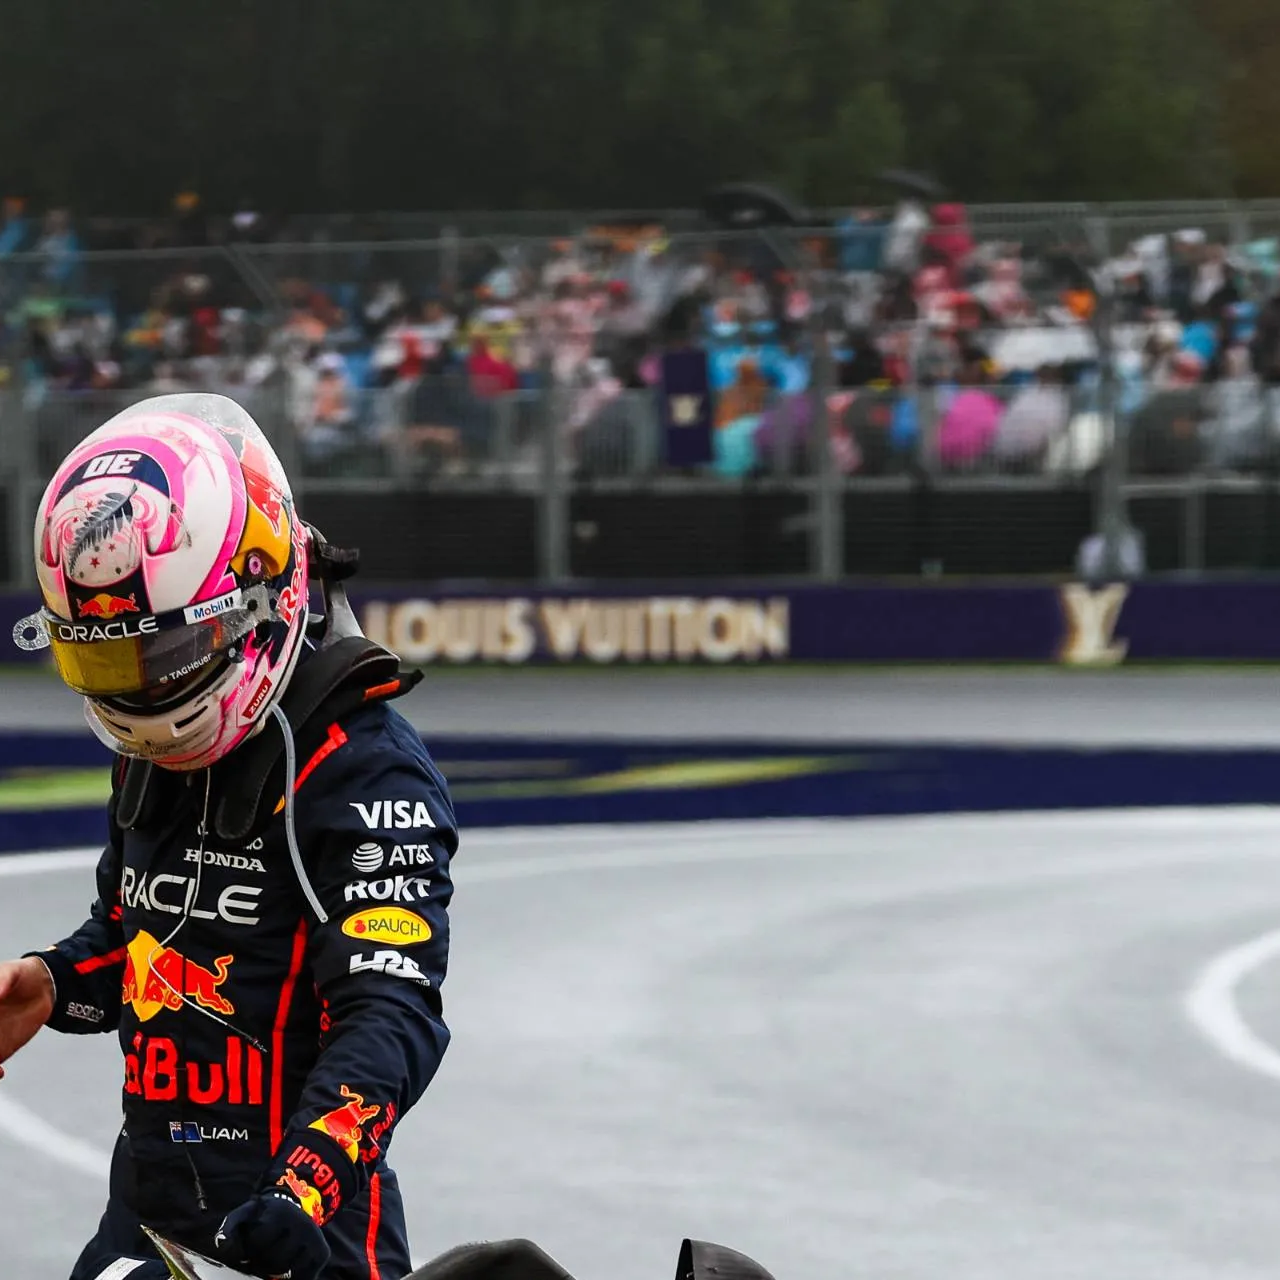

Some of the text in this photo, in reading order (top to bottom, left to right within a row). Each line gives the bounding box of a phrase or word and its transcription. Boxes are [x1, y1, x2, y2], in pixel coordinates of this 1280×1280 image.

[58, 616, 159, 642] ORACLE
[364, 599, 790, 663] LOUIS VUITTON
[248, 682, 271, 715] ZURU
[349, 800, 436, 829] VISA
[183, 849, 267, 873] HONDA
[120, 866, 264, 925] RACLE
[344, 875, 431, 902] ROKT
[368, 919, 421, 937] RAUCH
[200, 1126, 249, 1140] LIAM
